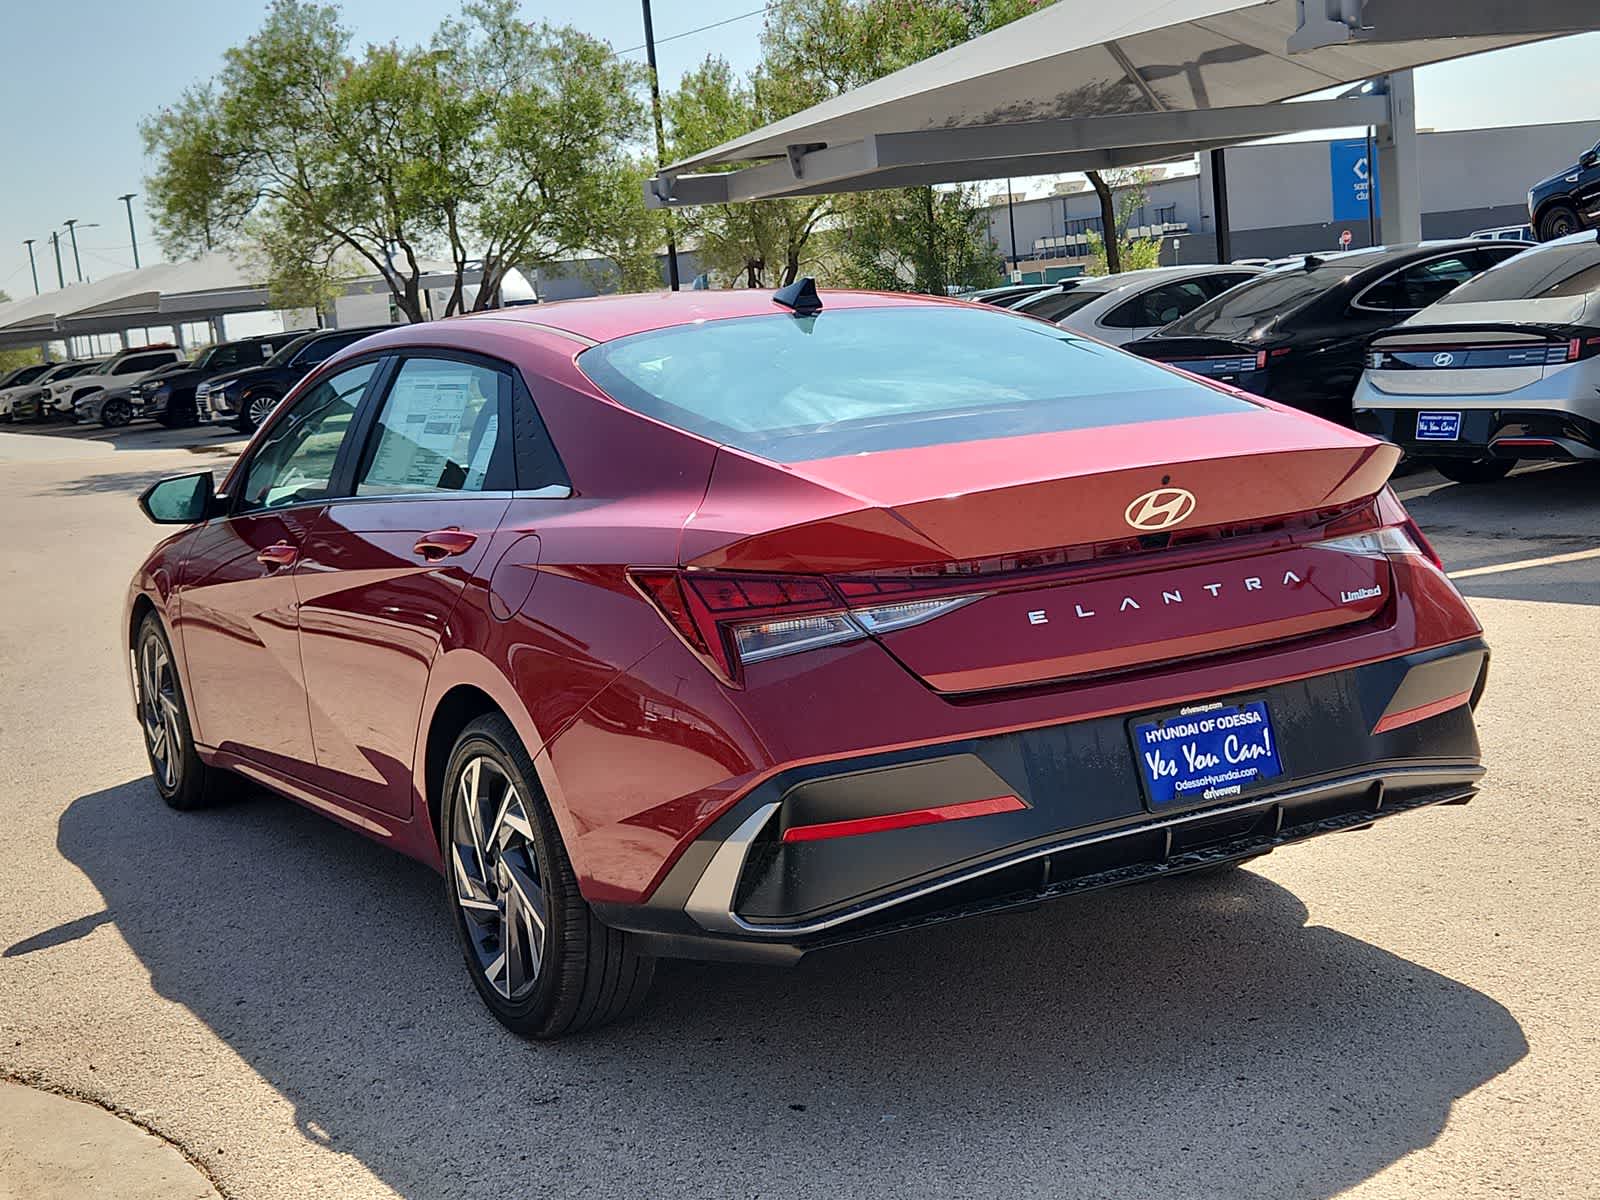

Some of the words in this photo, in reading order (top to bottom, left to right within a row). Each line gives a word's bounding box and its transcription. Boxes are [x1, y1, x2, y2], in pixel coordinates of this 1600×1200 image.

[1028, 571, 1301, 625] ELANTRA
[1340, 584, 1382, 603] Limited
[1180, 702, 1223, 716] driveway.com
[1145, 723, 1199, 743] HYUNDAI
[1199, 719, 1215, 733] OF
[1216, 711, 1262, 730] ODESSA
[1145, 749, 1178, 780] Yes
[1182, 742, 1220, 773] You
[1224, 727, 1272, 764] Can!
[1175, 767, 1258, 791] OdessaHyundai.com
[1203, 784, 1241, 800] driveway
